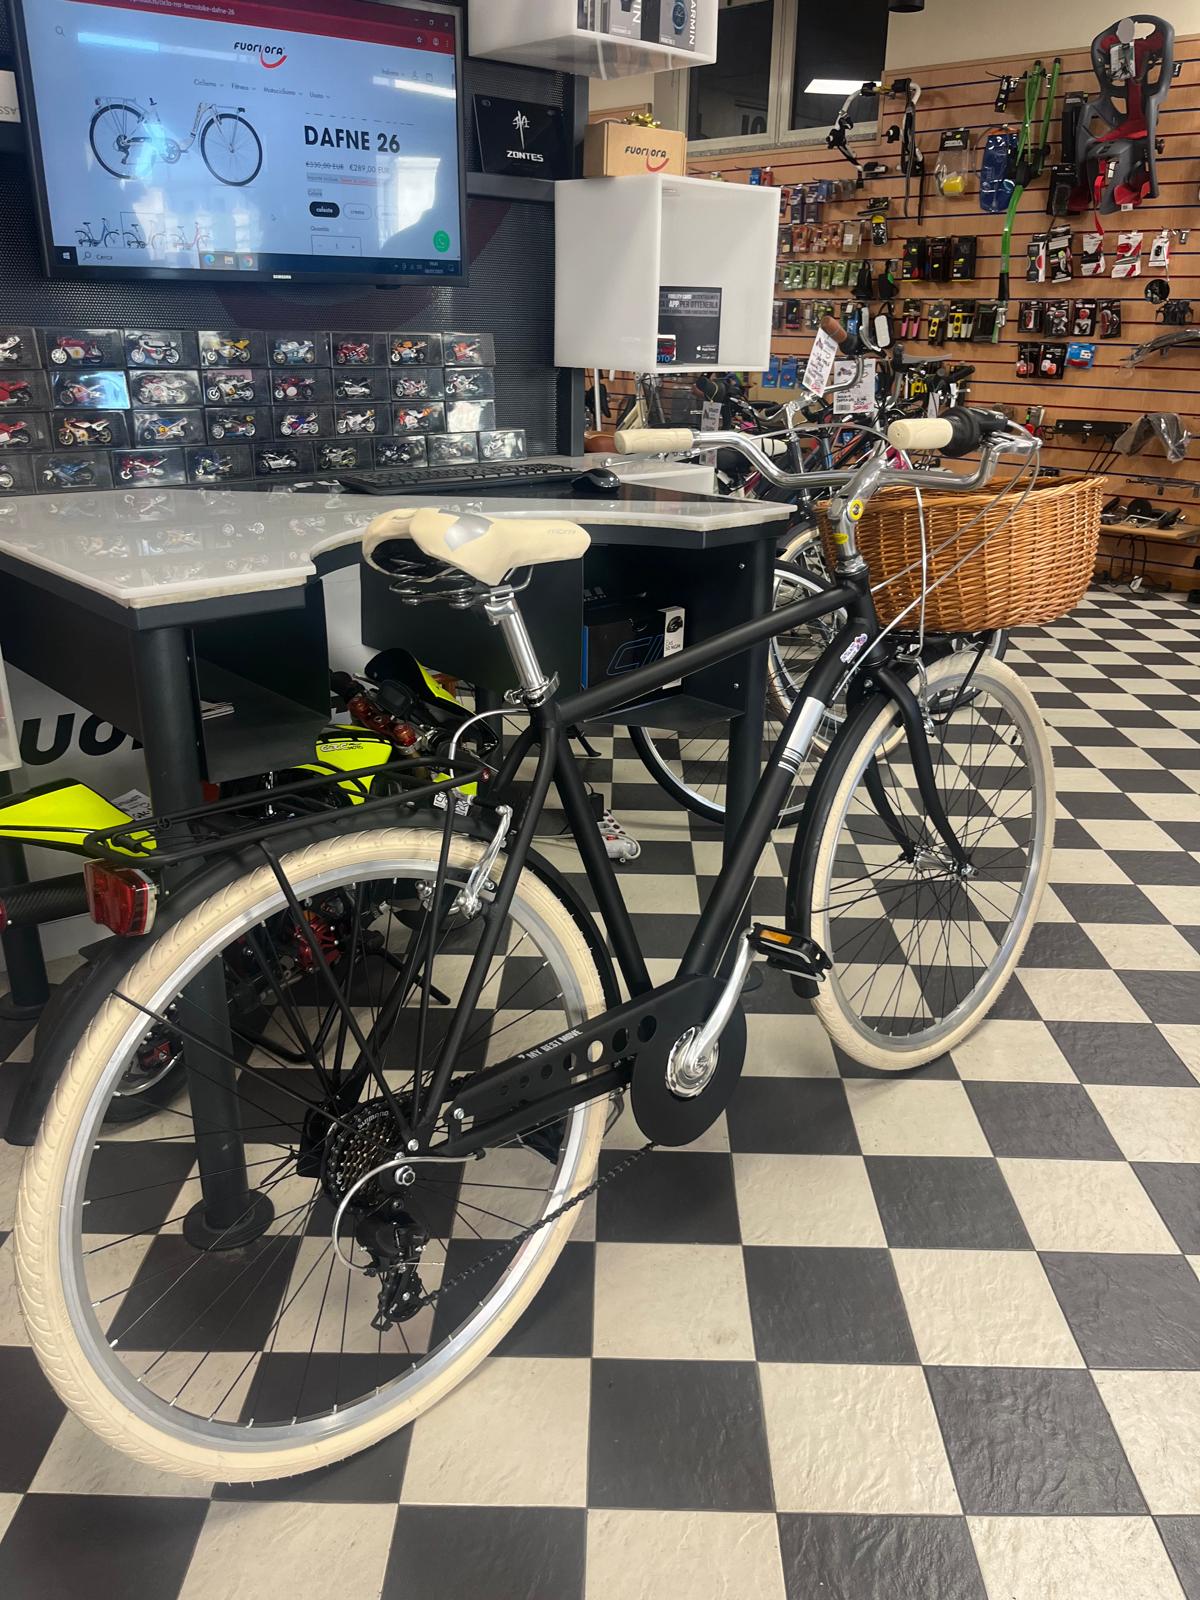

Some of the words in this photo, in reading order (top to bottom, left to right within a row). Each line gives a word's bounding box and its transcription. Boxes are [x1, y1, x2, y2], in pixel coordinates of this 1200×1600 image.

[689, 0, 697, 45] ARMIN
[304, 125, 370, 151] DAFNE
[377, 132, 400, 154] 26
[506, 150, 544, 162] ZONTES
[525, 1049, 542, 1059] MY
[540, 1040, 562, 1052] BEST
[558, 1029, 583, 1043] MOVE
